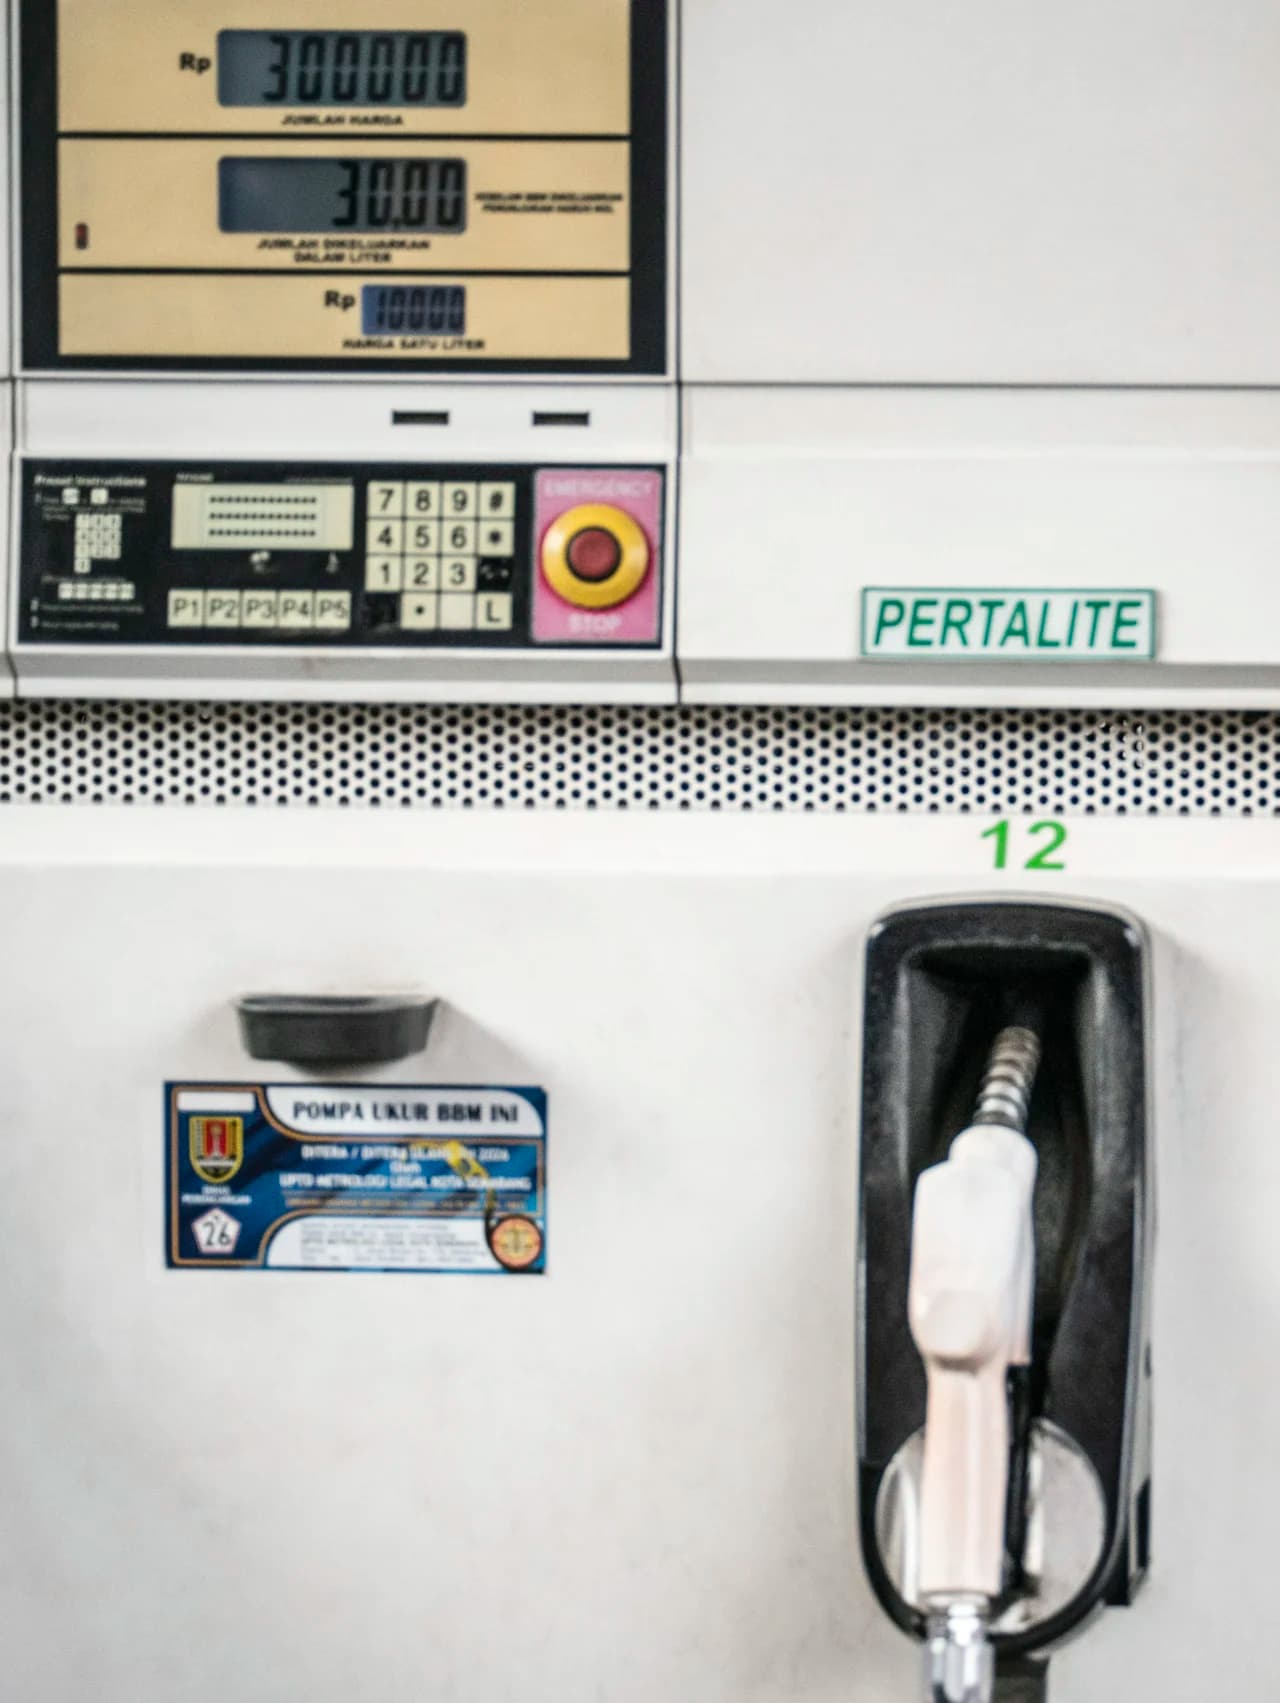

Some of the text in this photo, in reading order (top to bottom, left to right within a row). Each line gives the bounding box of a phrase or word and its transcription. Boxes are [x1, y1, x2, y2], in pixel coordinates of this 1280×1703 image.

[179, 53, 211, 74] Rp
[262, 35, 465, 102] 300000
[324, 290, 356, 311] Rp
[376, 289, 465, 331] 10000
[379, 489, 394, 511] 7
[415, 489, 430, 511] 8
[451, 490, 467, 512] 9
[378, 526, 467, 548] 4 5 6
[381, 563, 390, 585] 1
[413, 563, 429, 585] 2
[450, 563, 465, 585] 3
[174, 598, 348, 619] P1 P2 P3 P4 P5
[486, 601, 500, 622] L
[567, 614, 622, 634] STOP
[873, 598, 1142, 648] PERTALITE
[981, 819, 1069, 870] 12
[293, 1102, 519, 1122] POMPA UKUR BBM INI
[203, 1221, 231, 1246] 26
